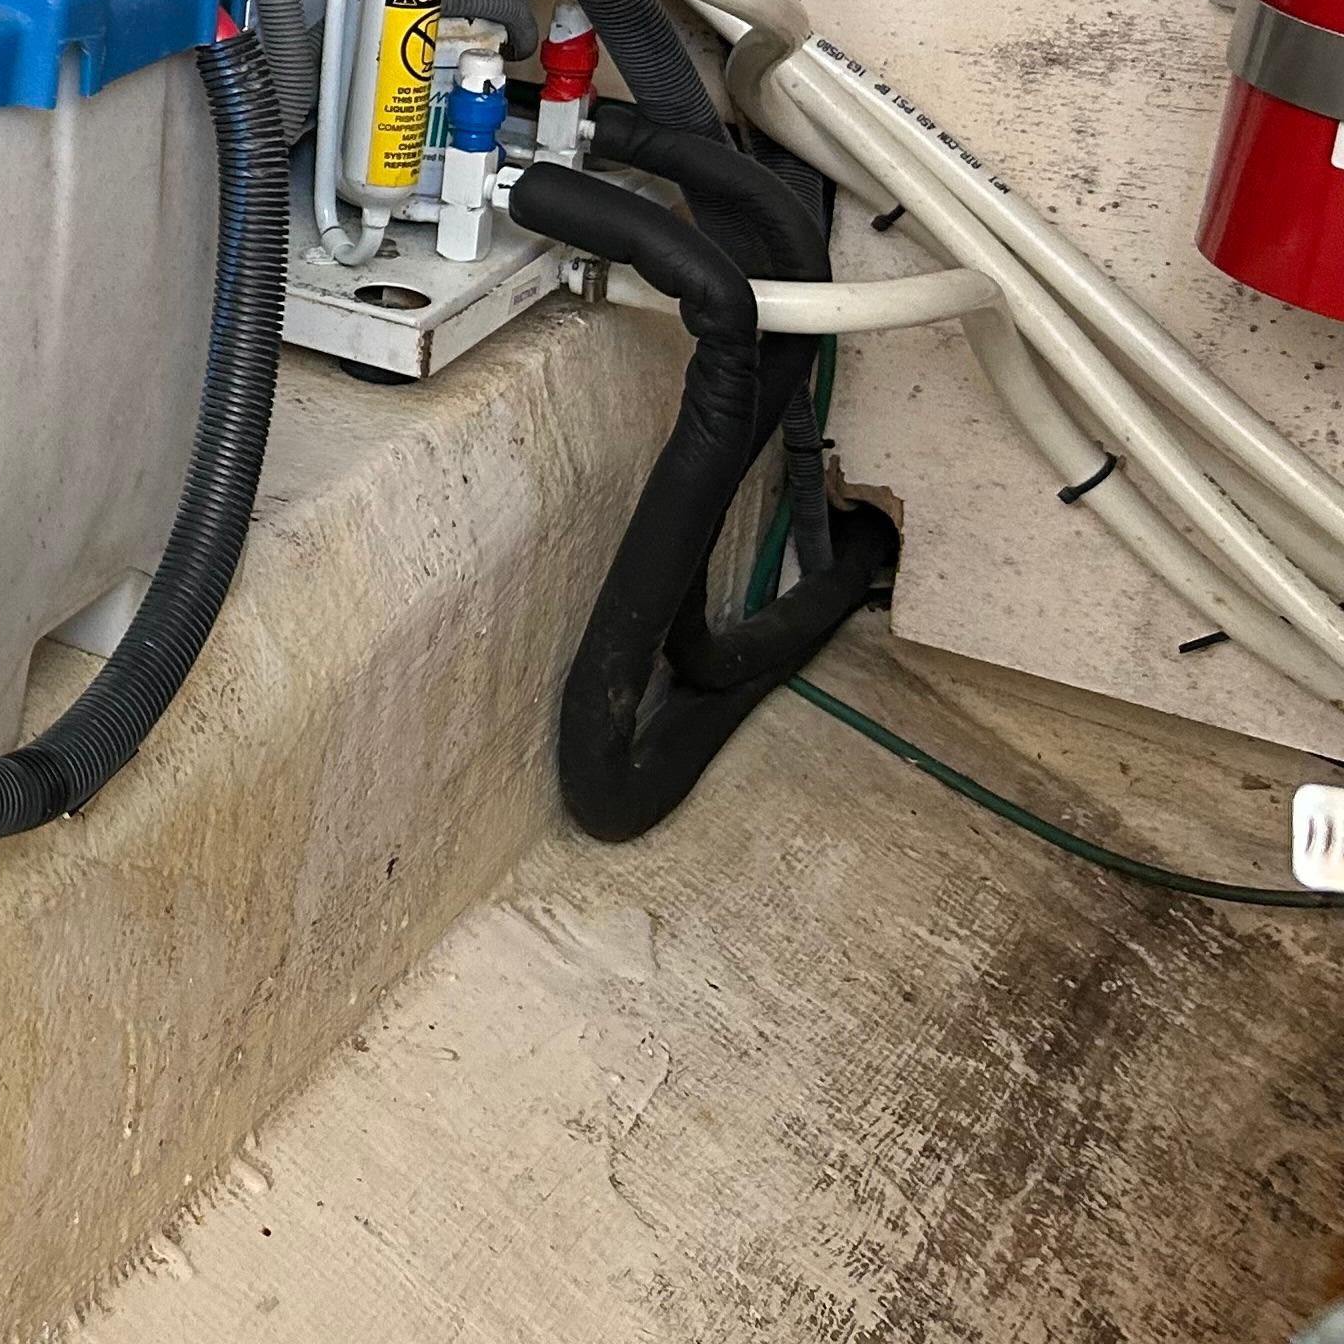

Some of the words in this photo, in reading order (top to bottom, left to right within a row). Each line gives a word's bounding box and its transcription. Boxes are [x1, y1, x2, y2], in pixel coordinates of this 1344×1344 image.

[816, 39, 867, 77] 163-0580
[397, 87, 412, 95] DO
[392, 96, 413, 104] THIS
[892, 95, 915, 115] PSI
[384, 104, 415, 113] LIQUID
[395, 114, 415, 123] RISK
[916, 114, 937, 131] 450
[936, 131, 983, 170] AIR-CON
